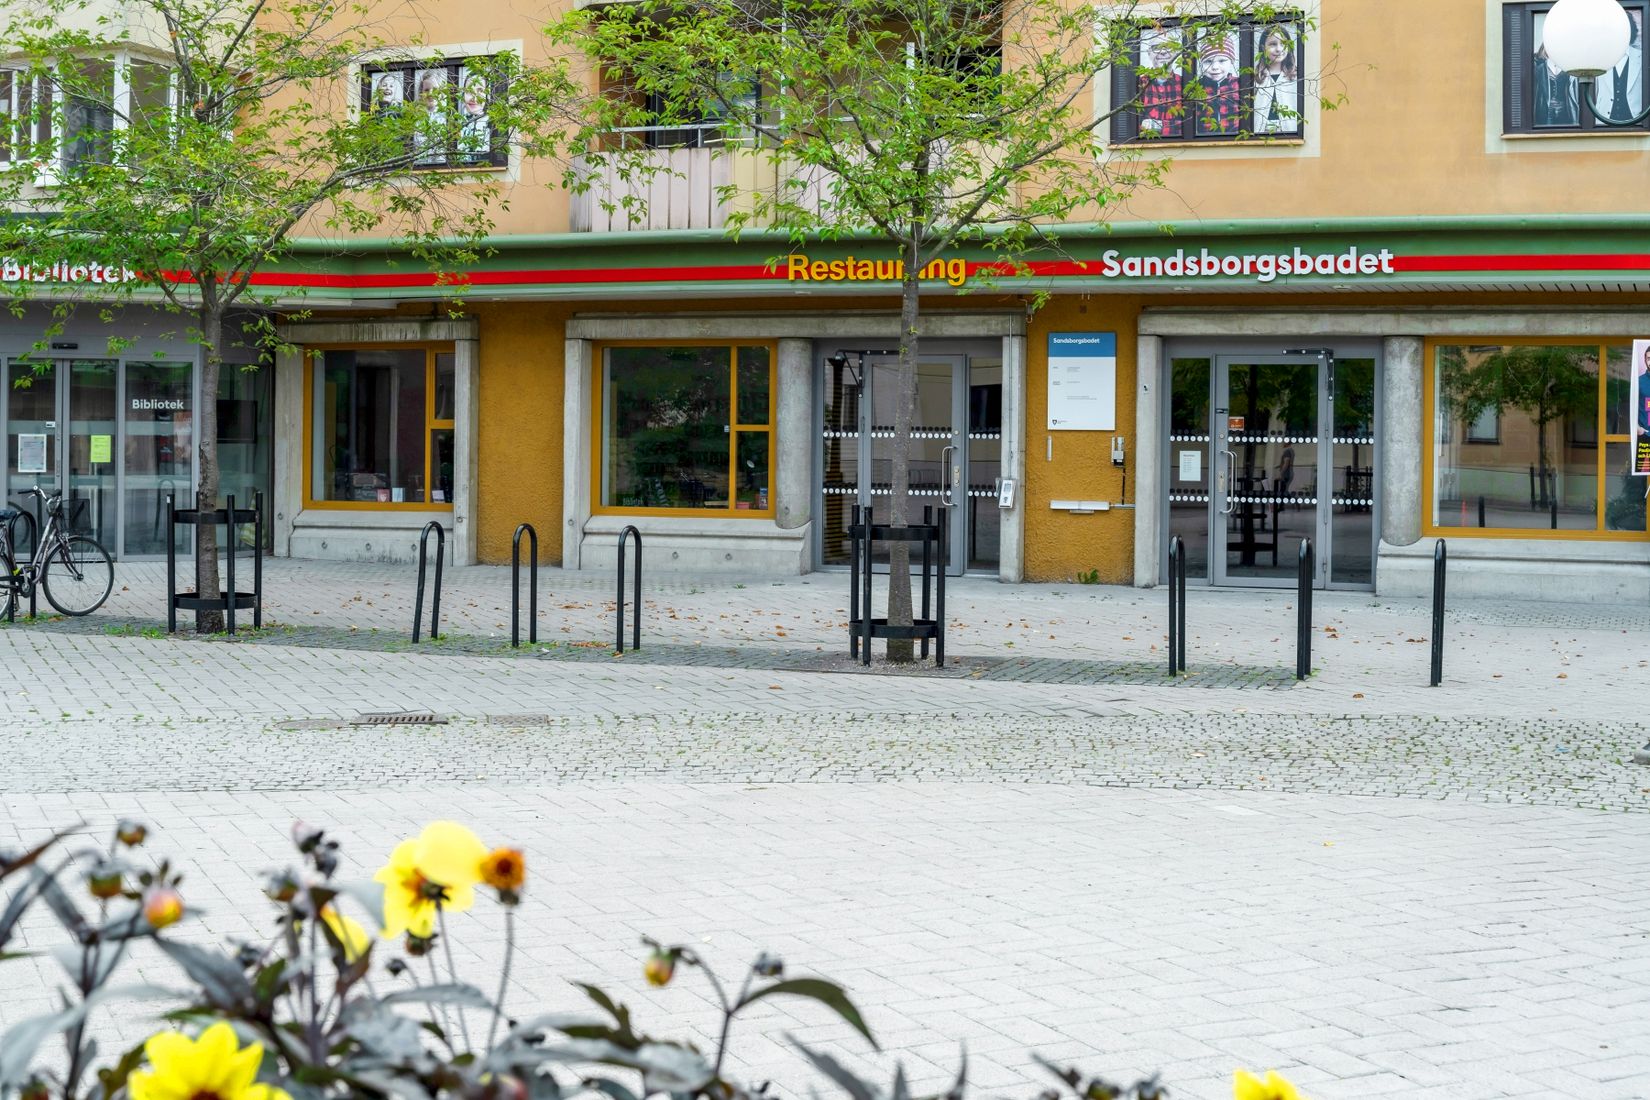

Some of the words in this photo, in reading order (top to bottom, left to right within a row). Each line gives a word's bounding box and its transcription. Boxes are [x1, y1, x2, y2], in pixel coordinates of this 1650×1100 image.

[788, 254, 966, 286] Restaurng
[1102, 247, 1394, 282] Sandsborgsbadet
[1053, 337, 1100, 345] Sandsborgsbadet
[132, 399, 184, 409] Bibliotek
